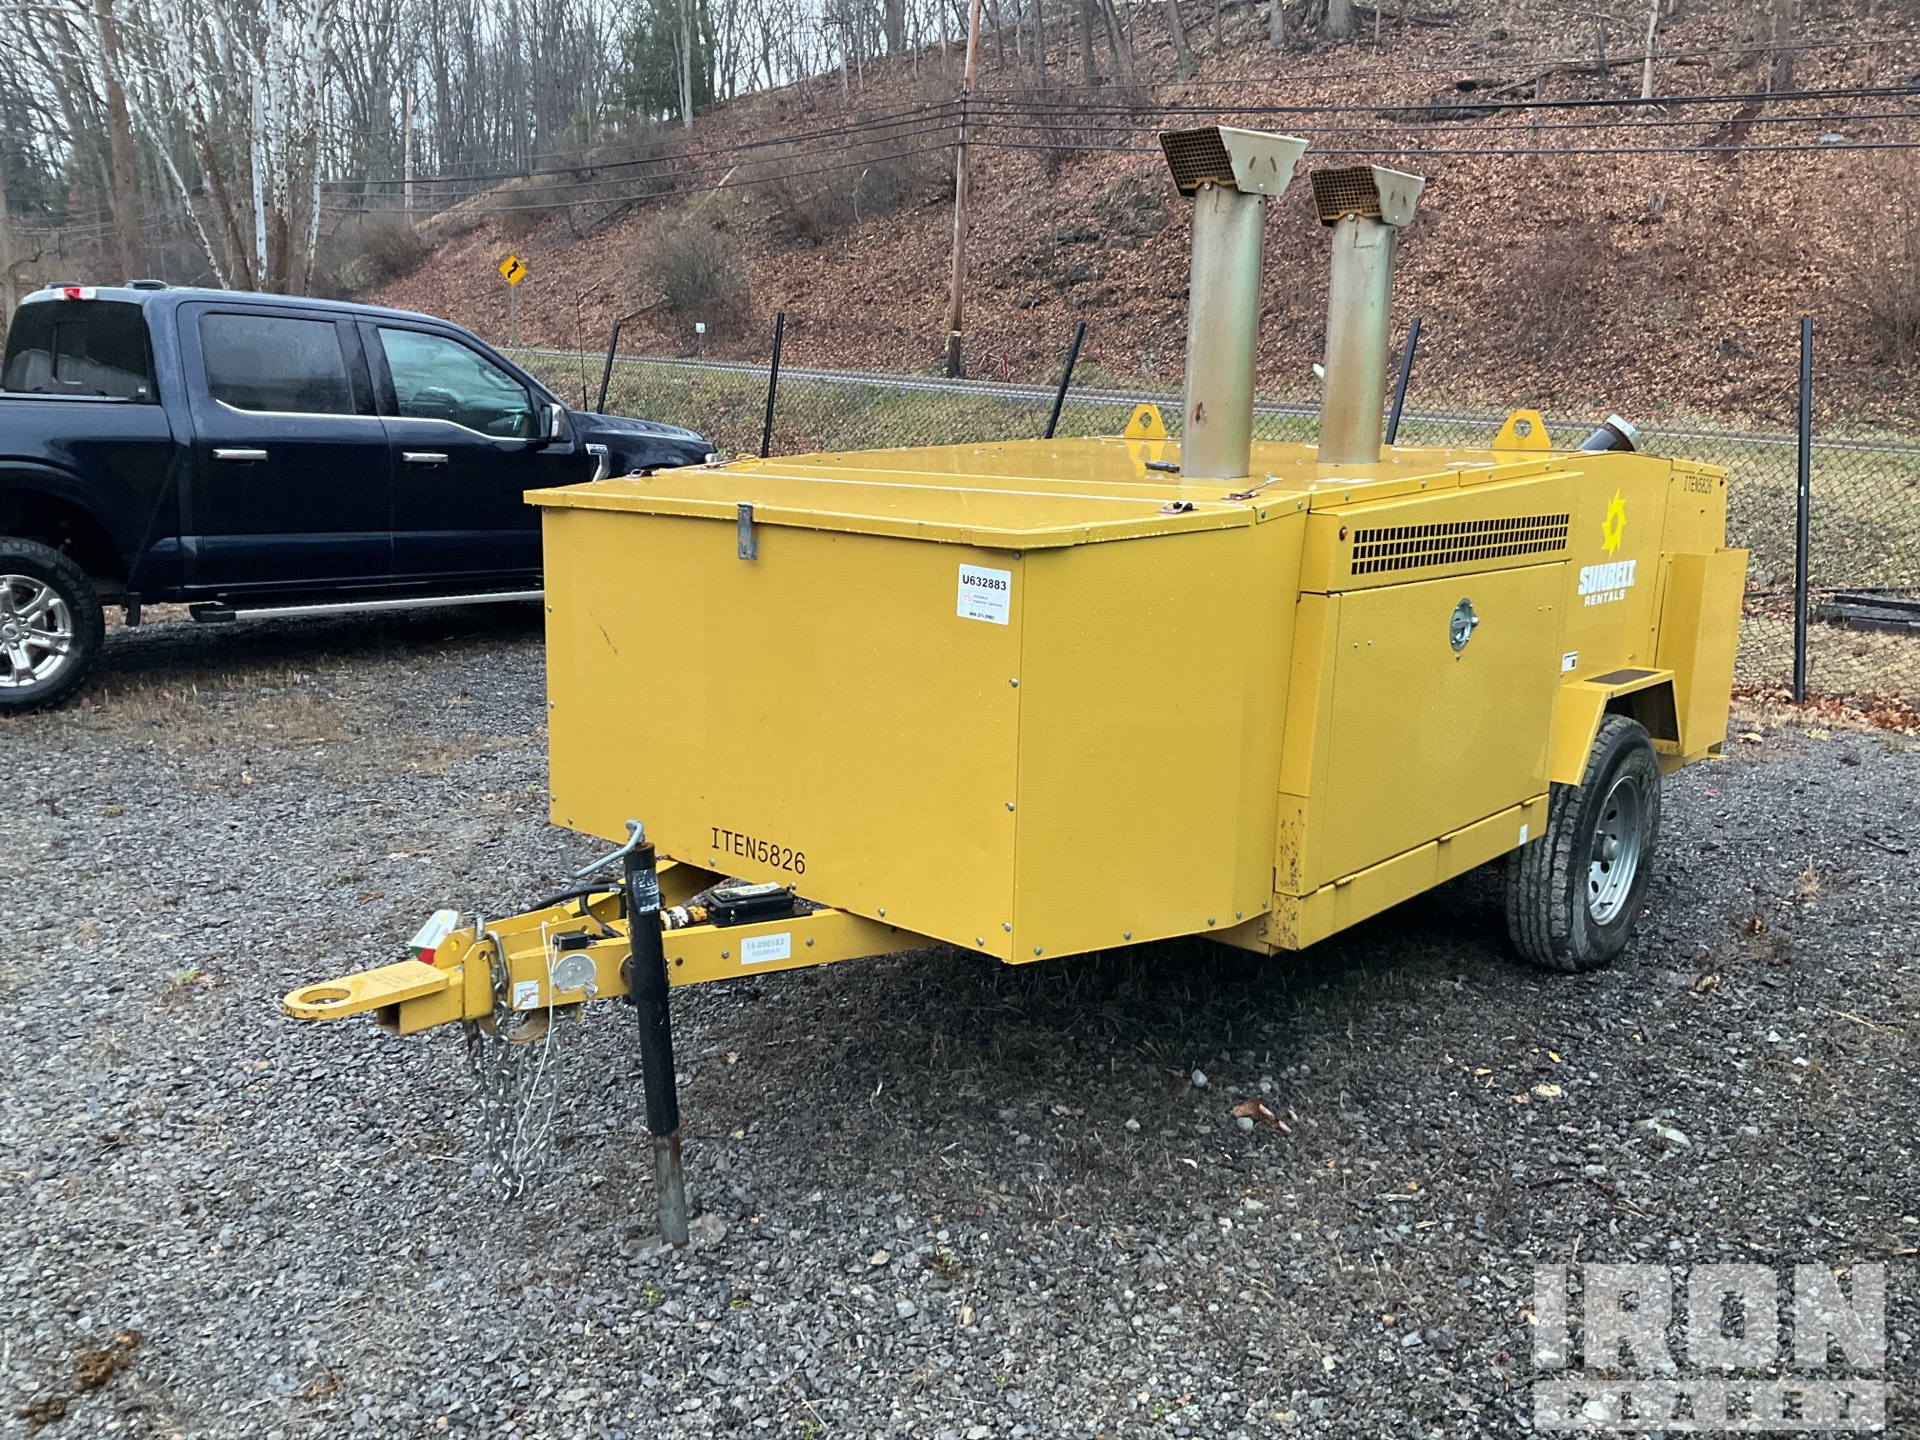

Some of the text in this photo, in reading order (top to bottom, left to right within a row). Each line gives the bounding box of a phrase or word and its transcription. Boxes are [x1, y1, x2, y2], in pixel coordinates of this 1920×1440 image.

[1683, 475, 1713, 494] ITEN5826
[962, 574, 1007, 591] U632883
[1578, 559, 1637, 595] SUNBELT
[1584, 589, 1626, 607] RENTALS
[711, 826, 806, 875] ITEN5826
